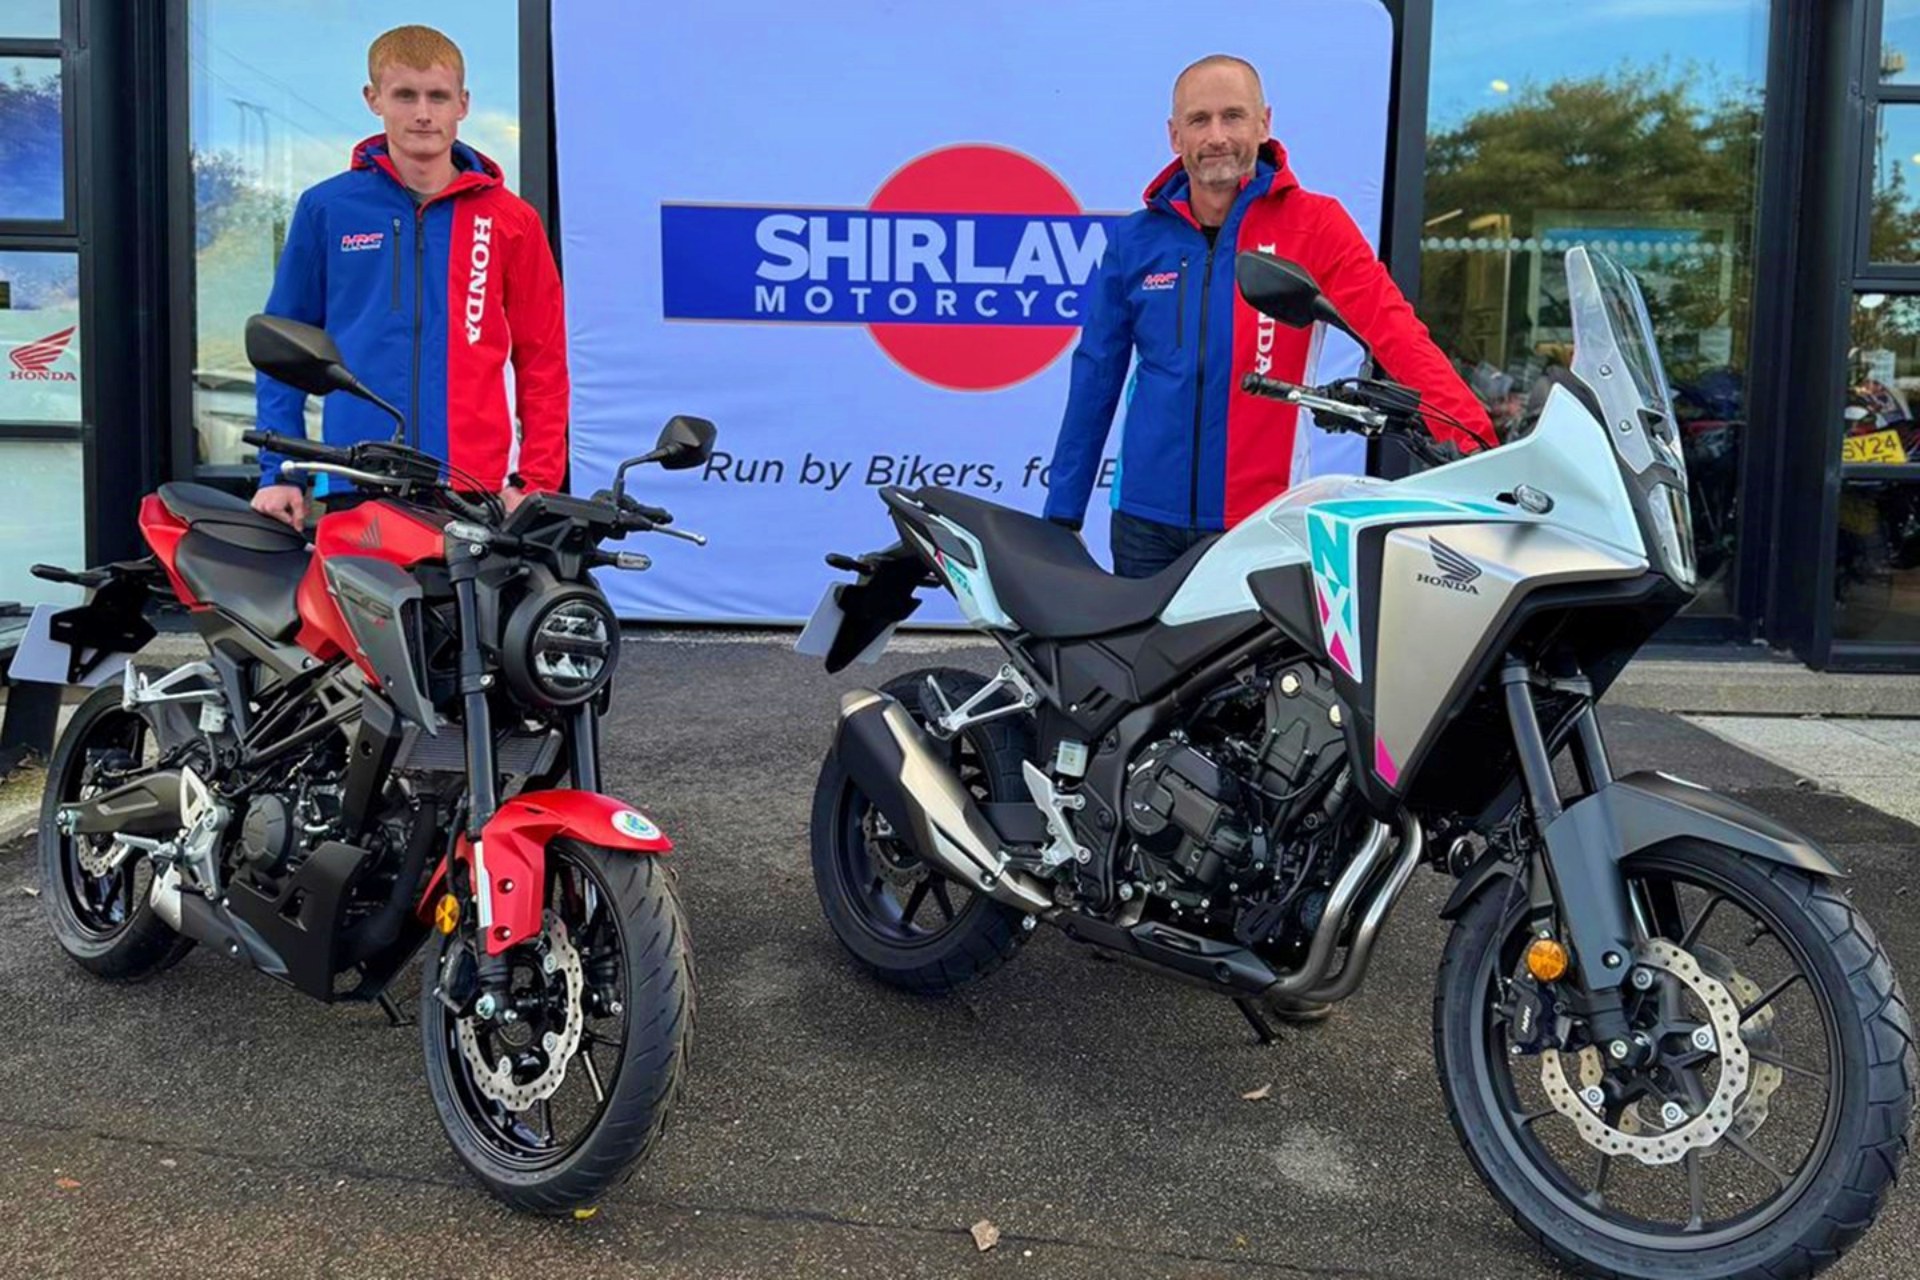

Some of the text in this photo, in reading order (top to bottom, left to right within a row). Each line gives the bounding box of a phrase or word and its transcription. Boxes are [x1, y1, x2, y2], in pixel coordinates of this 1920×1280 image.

[755, 213, 1109, 286] SHIRLAW
[465, 214, 493, 346] HONDA
[755, 285, 1080, 318] MOTORCYC
[9, 370, 77, 381] HONDA
[702, 451, 784, 484] Run
[799, 452, 852, 491] by
[865, 454, 1004, 493] Bikers,
[1416, 573, 1480, 596] HONDA
